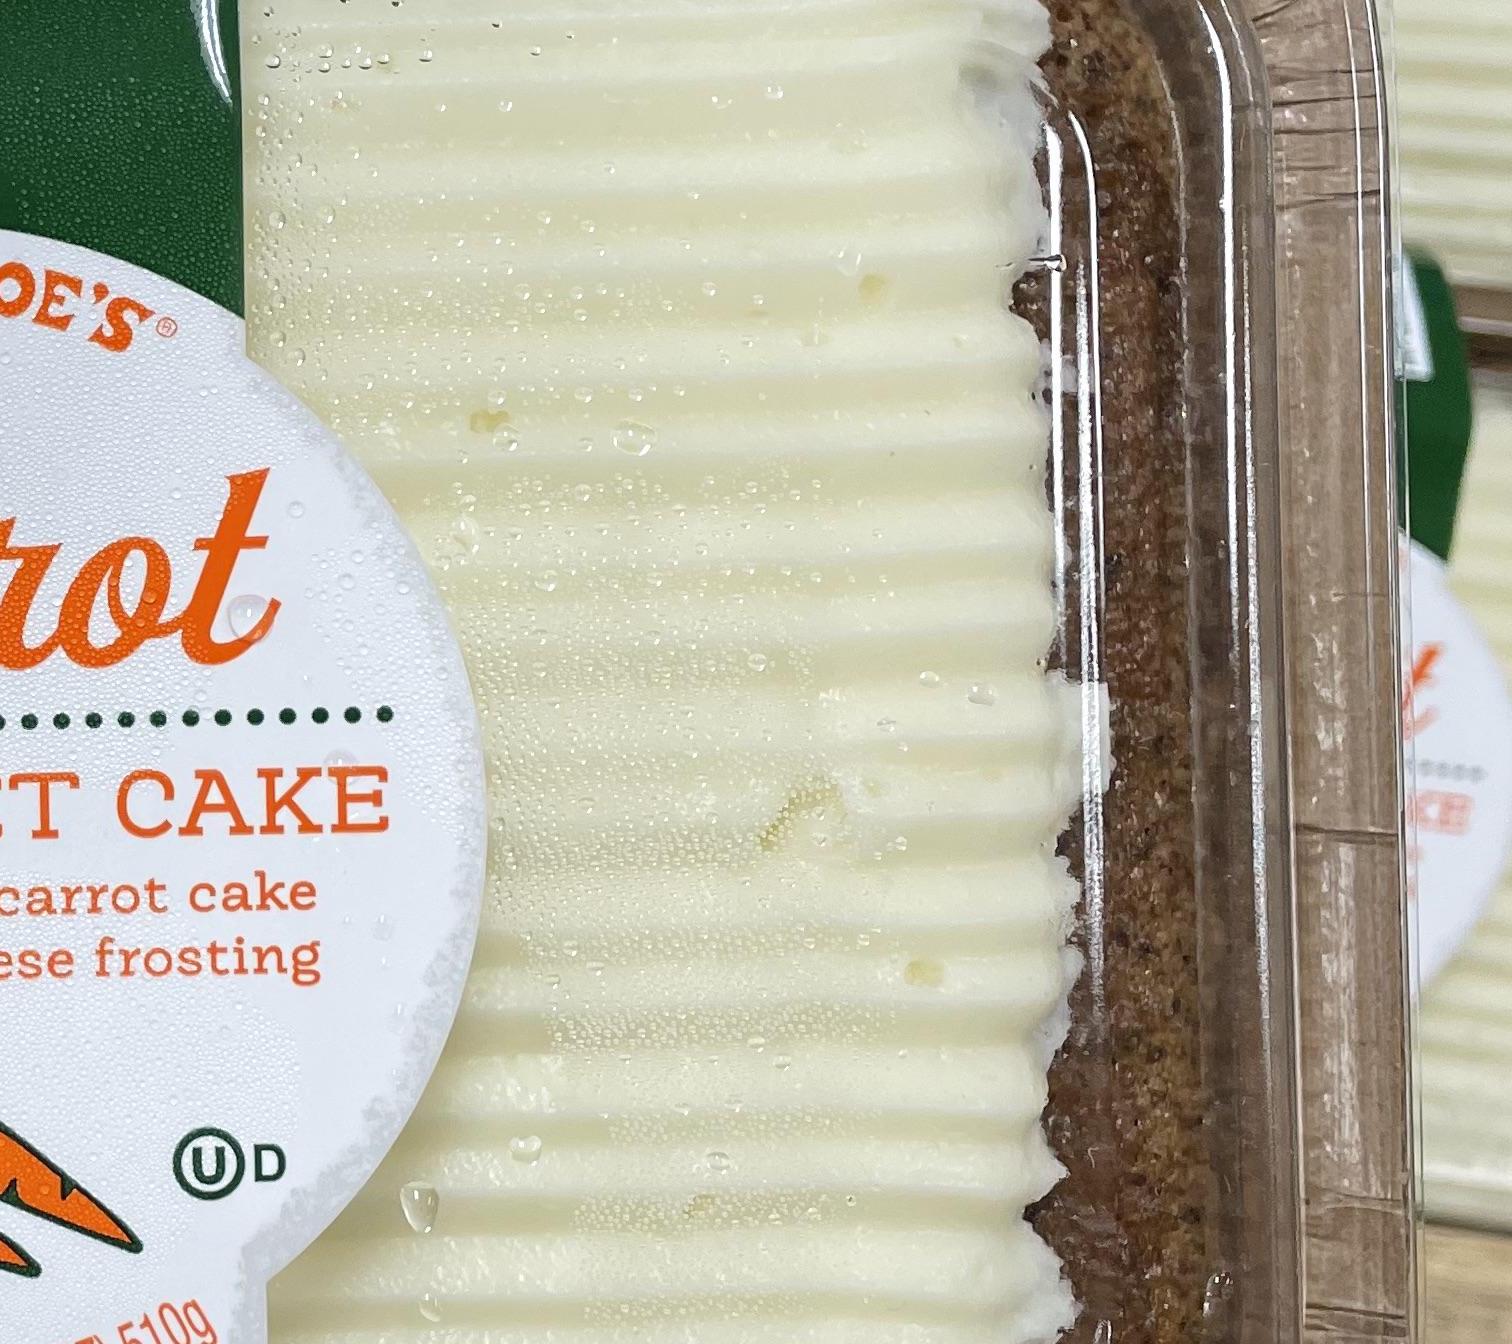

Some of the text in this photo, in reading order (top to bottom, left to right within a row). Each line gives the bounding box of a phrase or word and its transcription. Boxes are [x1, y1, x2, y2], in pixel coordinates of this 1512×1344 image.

[116, 766, 389, 838] CAKE
[189, 871, 316, 912] cake
[97, 937, 320, 986] frosting
